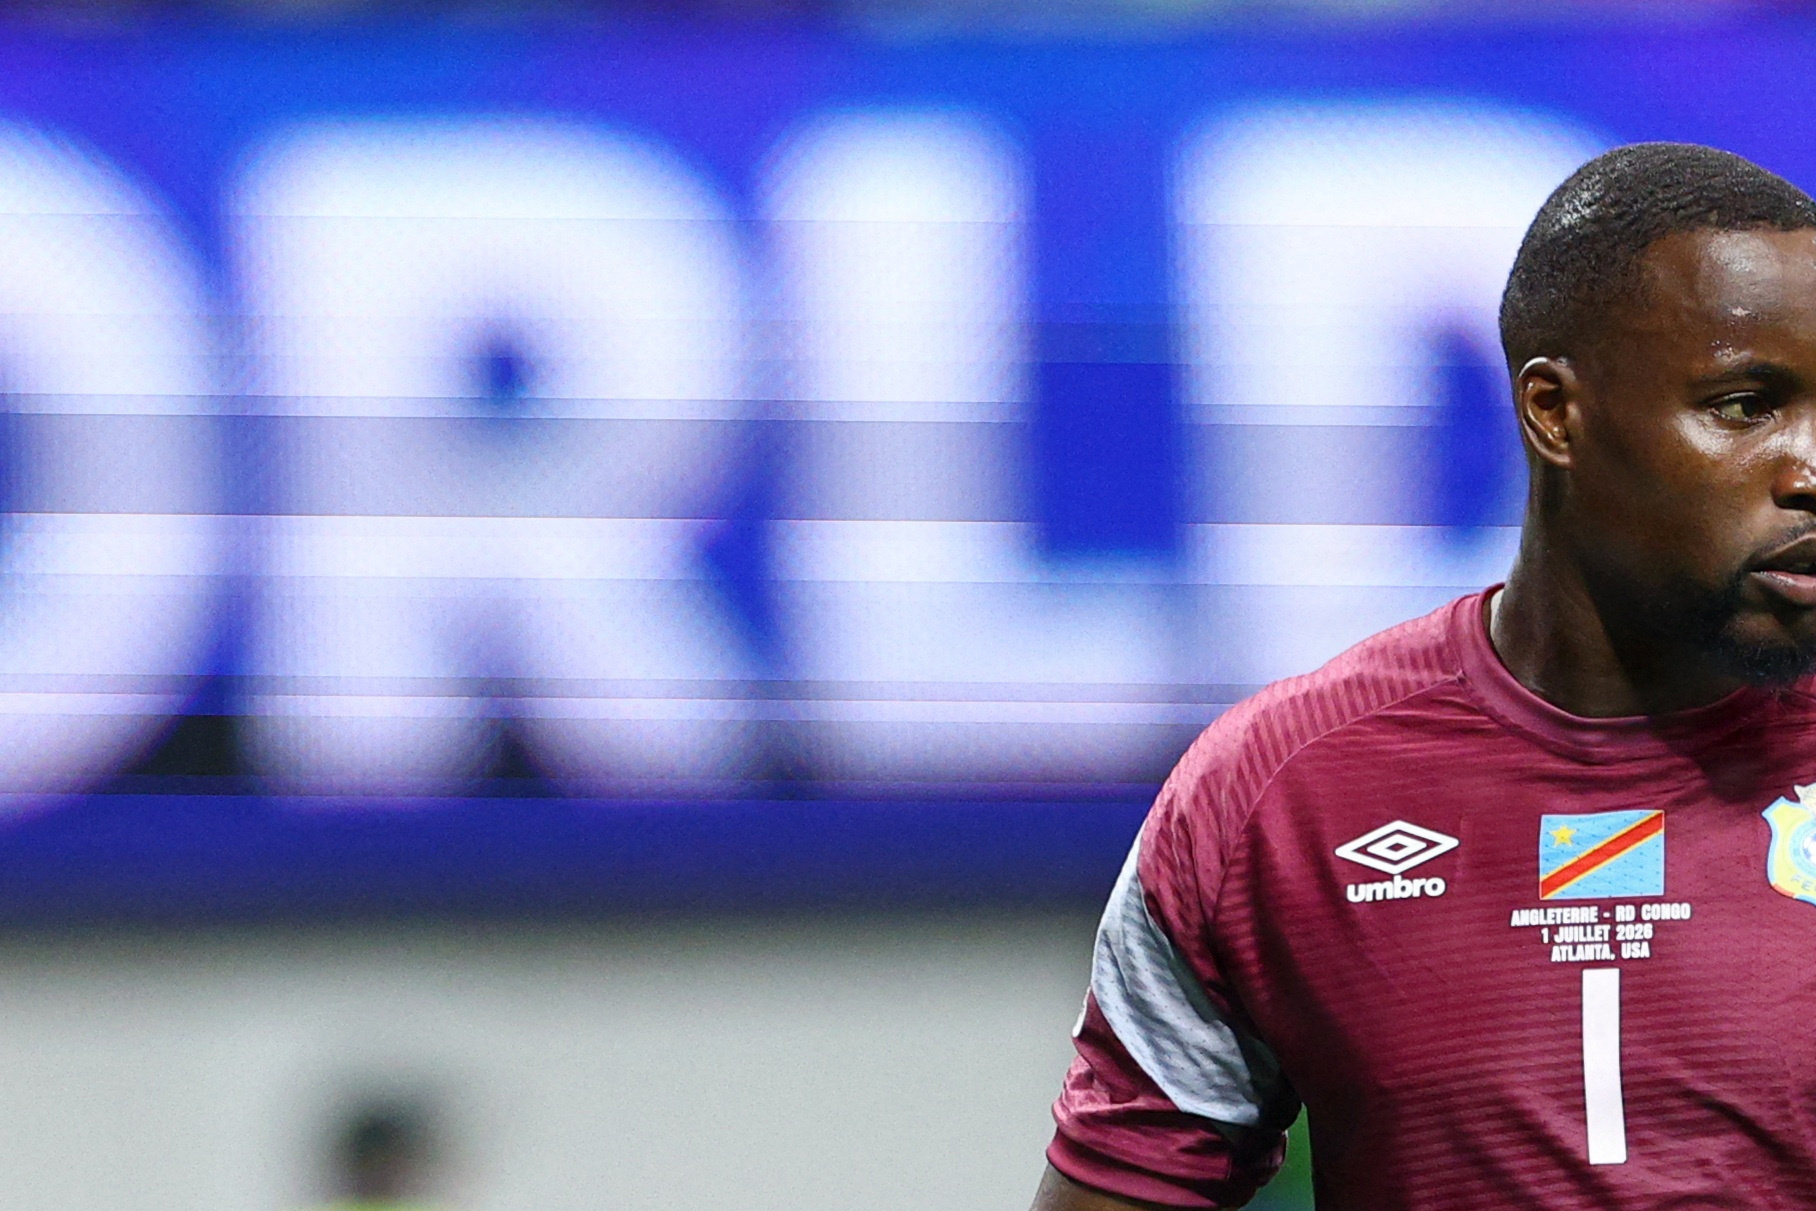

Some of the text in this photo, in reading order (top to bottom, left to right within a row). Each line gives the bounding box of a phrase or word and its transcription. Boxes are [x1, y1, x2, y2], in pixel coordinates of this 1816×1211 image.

[1346, 874, 1446, 903] umbro
[1511, 907, 1598, 925] ANGLETERRE
[1615, 905, 1636, 922] RD
[1641, 903, 1692, 920] CONGO
[1540, 923, 1653, 944] 1 JUILLET 2026
[1551, 942, 1651, 962] ATLANTA, USA
[1581, 967, 1628, 1165] 1
